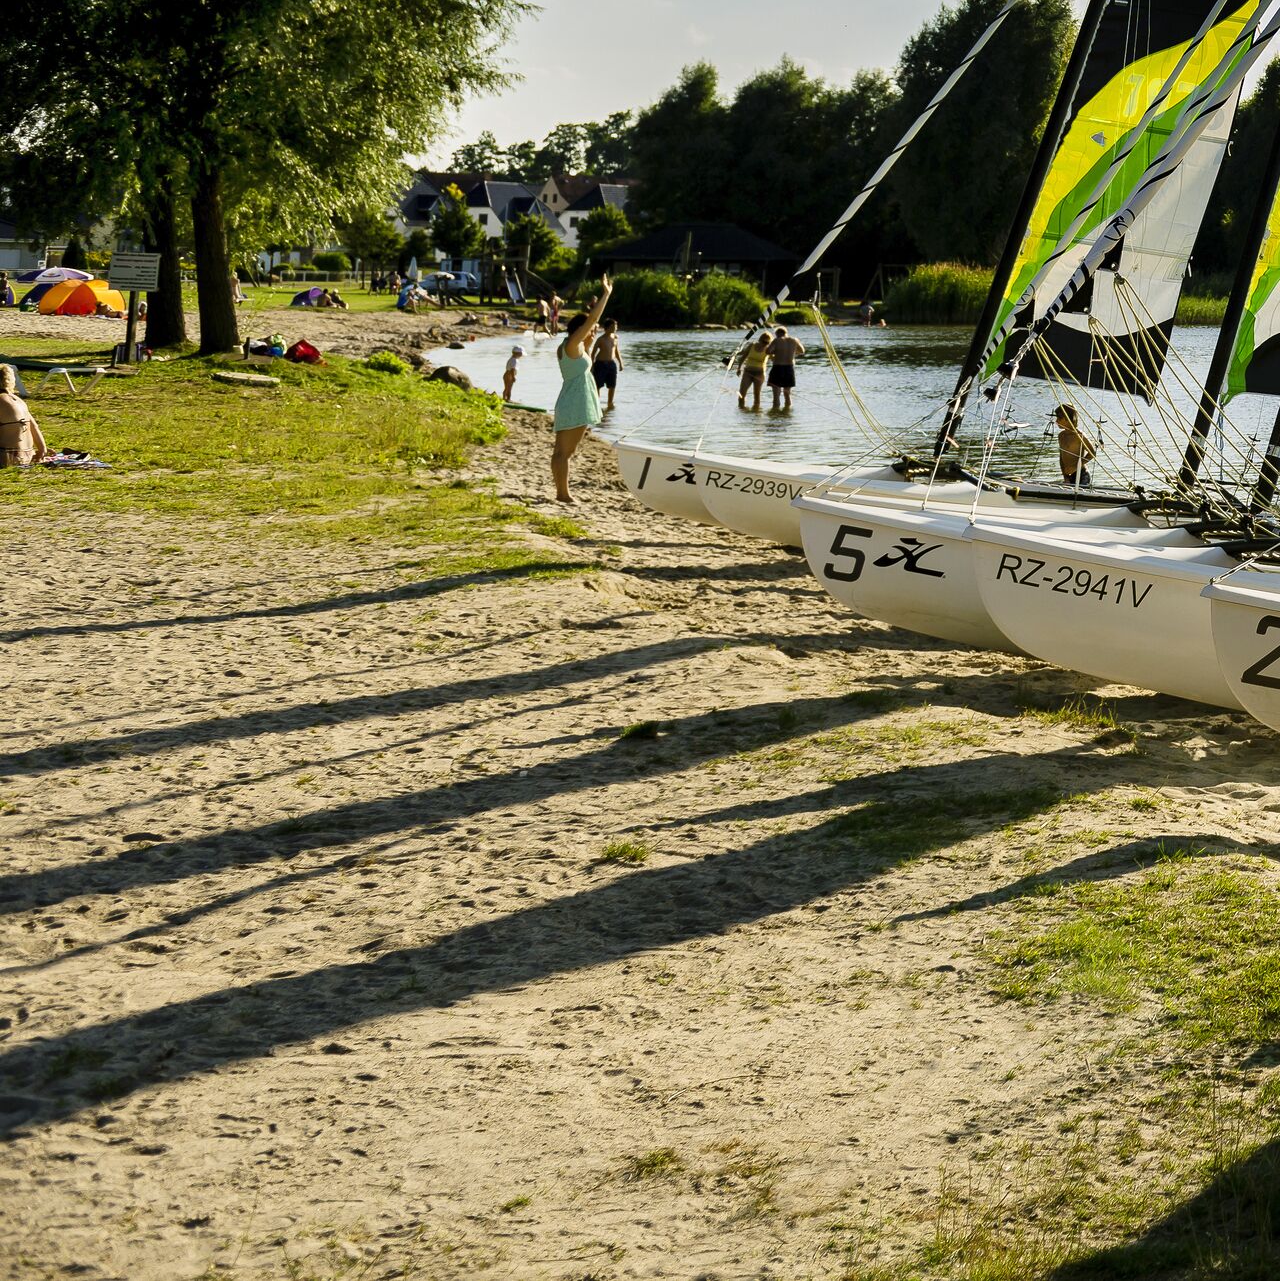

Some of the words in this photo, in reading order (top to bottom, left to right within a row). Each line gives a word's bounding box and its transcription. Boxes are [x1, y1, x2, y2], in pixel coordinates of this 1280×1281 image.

[637, 457, 652, 490] 1
[705, 470, 803, 501] RZ-2939V
[823, 524, 873, 582] 5
[996, 553, 1153, 608] RZ-2941V
